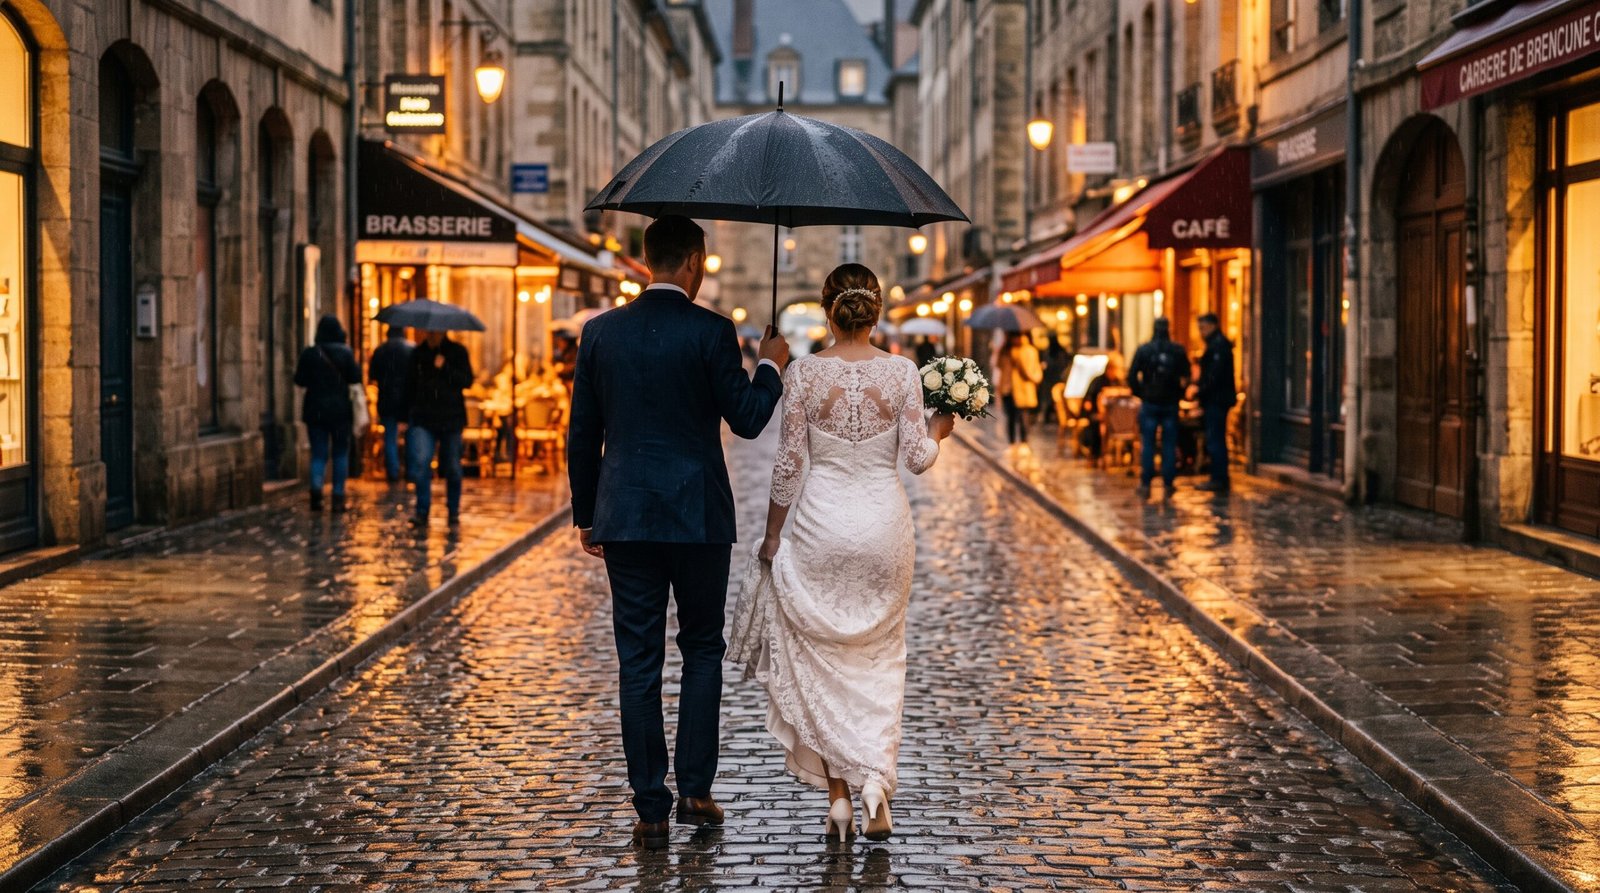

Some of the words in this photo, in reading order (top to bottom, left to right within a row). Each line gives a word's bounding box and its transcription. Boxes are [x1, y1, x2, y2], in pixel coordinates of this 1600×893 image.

[1460, 48, 1507, 93] CARBERE
[1509, 42, 1524, 75] DE
[366, 214, 492, 236] BRASSERIE
[1172, 214, 1230, 239] CAFÉ
